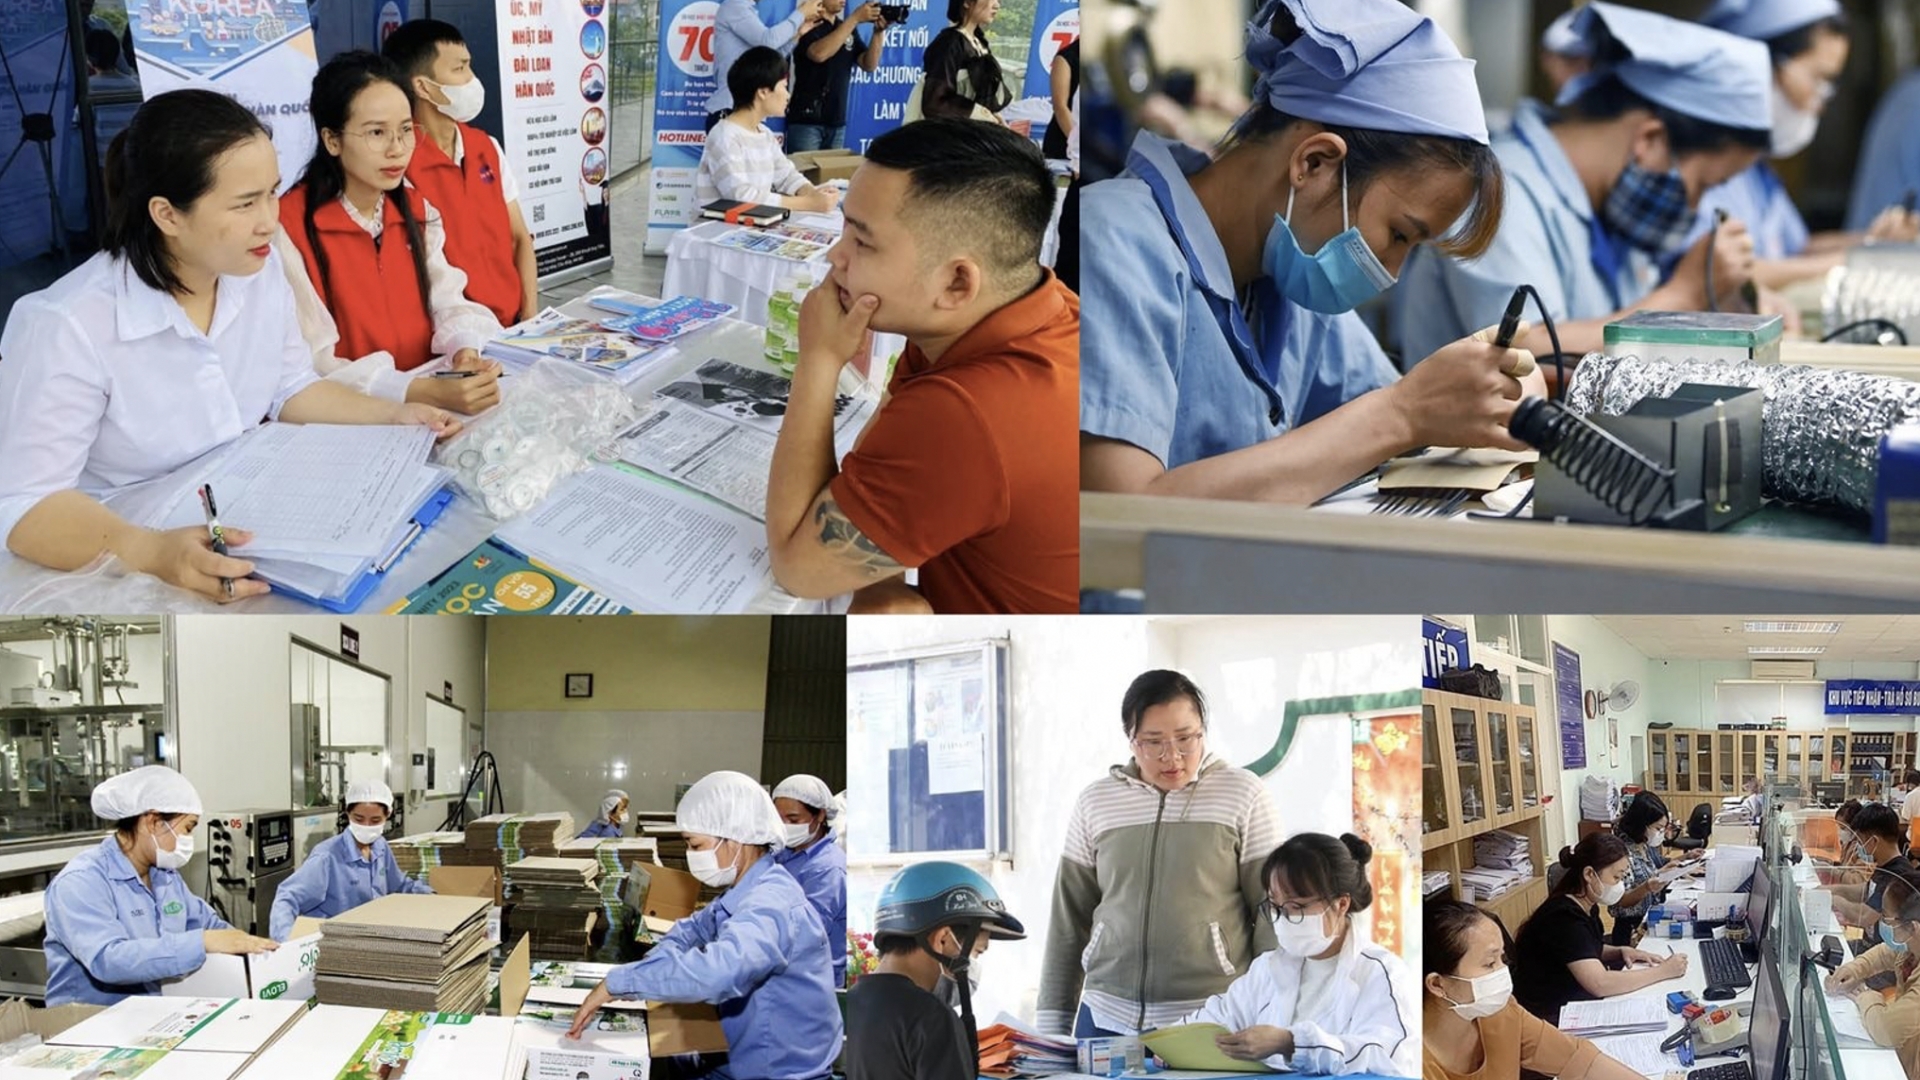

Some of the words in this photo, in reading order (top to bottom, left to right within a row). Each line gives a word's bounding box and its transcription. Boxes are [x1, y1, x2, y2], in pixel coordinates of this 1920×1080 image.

[512, 27, 536, 47] NHẬT
[538, 25, 553, 45] BẢN
[678, 26, 715, 62] 70
[882, 25, 906, 48] KẾT
[908, 25, 929, 48] NỐI
[513, 55, 529, 73] ĐÀI
[531, 57, 551, 72] LOAN
[873, 65, 922, 84] CHƯƠNG
[515, 80, 534, 98] HÀN
[535, 79, 555, 97] QUỐC
[873, 99, 900, 120] LÀM
[658, 132, 707, 143] HOTLINE:
[437, 582, 487, 614] ỌC
[512, 582, 538, 600] 55
[1422, 629, 1460, 679] TIẾP
[1828, 690, 1840, 706] KHU
[1841, 689, 1852, 709] VỰC
[1853, 685, 1865, 706] TIẾP
[230, 819, 242, 829] 05
[262, 982, 287, 998] ELOVI
